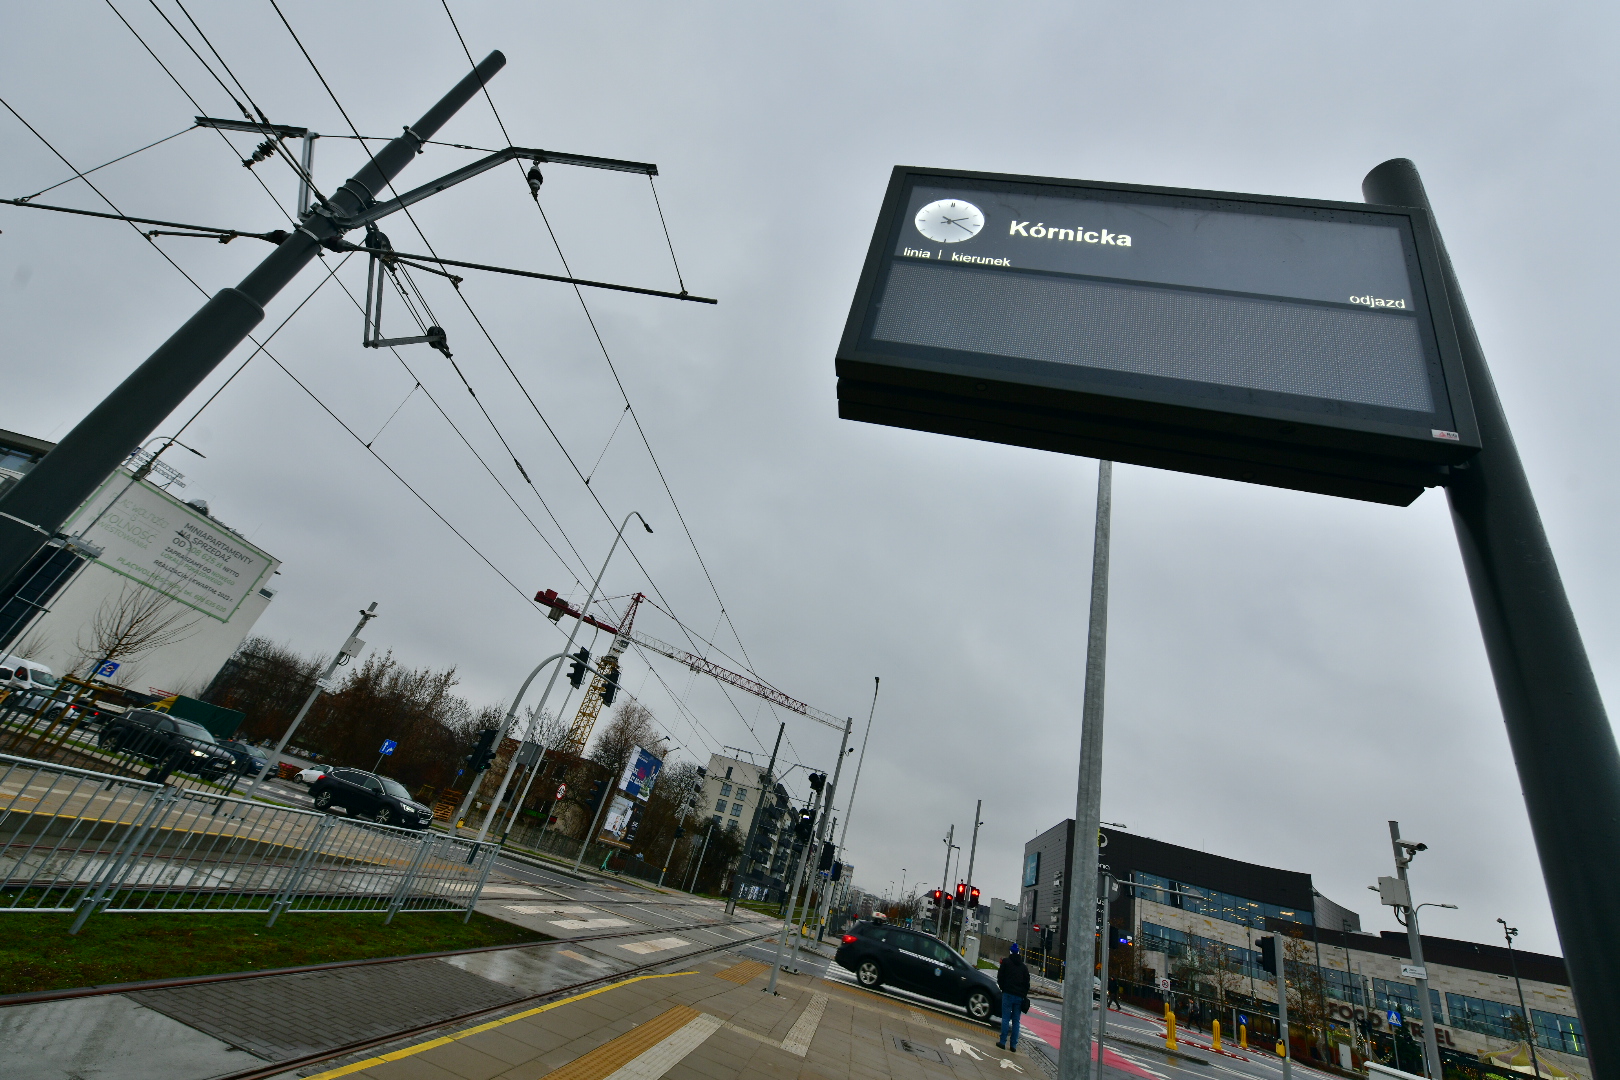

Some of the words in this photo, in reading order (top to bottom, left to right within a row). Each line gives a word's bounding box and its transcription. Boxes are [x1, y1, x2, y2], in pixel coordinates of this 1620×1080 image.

[1009, 220, 1132, 247] Kórnicka
[903, 247, 931, 259] linia
[952, 252, 1011, 267] kierunek
[1350, 295, 1406, 308] odjazd
[98, 507, 158, 544] WOLNOŚĆ
[172, 537, 186, 548] OD
[202, 553, 215, 564] 625
[222, 566, 240, 578] NETTO
[184, 522, 254, 565] MINIAPARTAMENTY
[192, 537, 232, 563] SPRZEDAŻ
[164, 546, 204, 569] ZAPRASZAMY
[212, 570, 236, 586] NOWEGO
